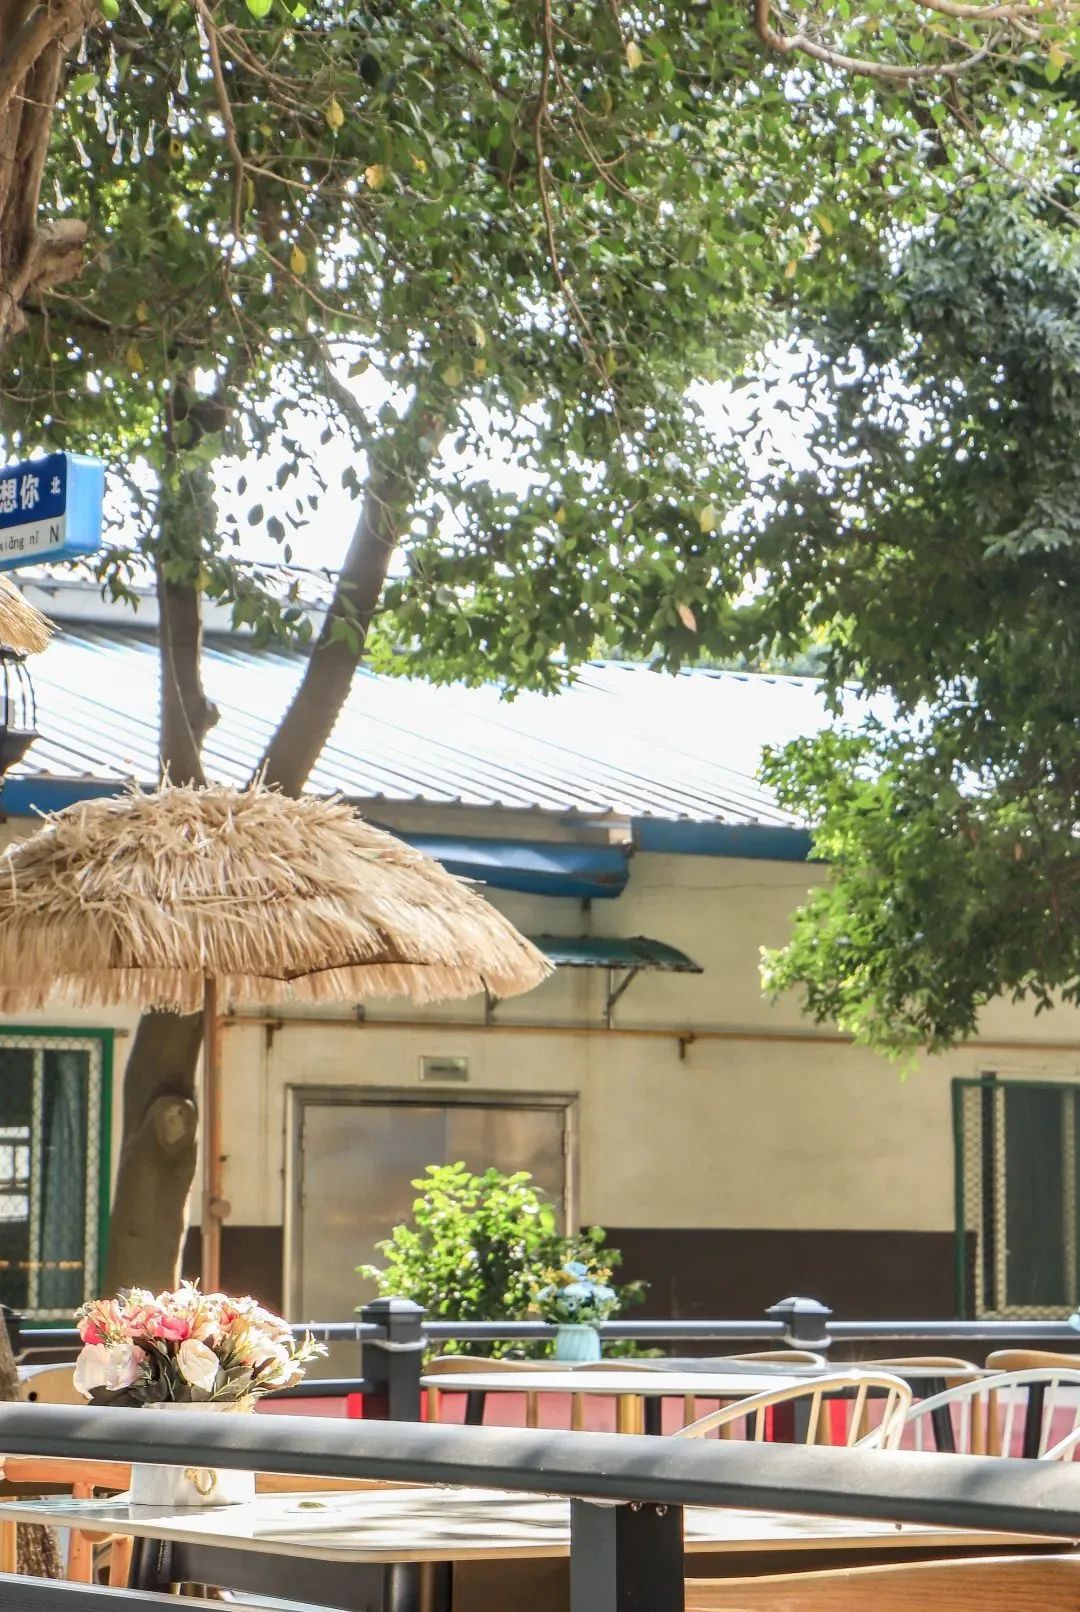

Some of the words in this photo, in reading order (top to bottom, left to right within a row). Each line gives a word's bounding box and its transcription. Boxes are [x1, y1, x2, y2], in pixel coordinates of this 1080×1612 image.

[0, 474, 40, 513] 想你
[50, 476, 61, 495] 北
[49, 523, 59, 543] N
